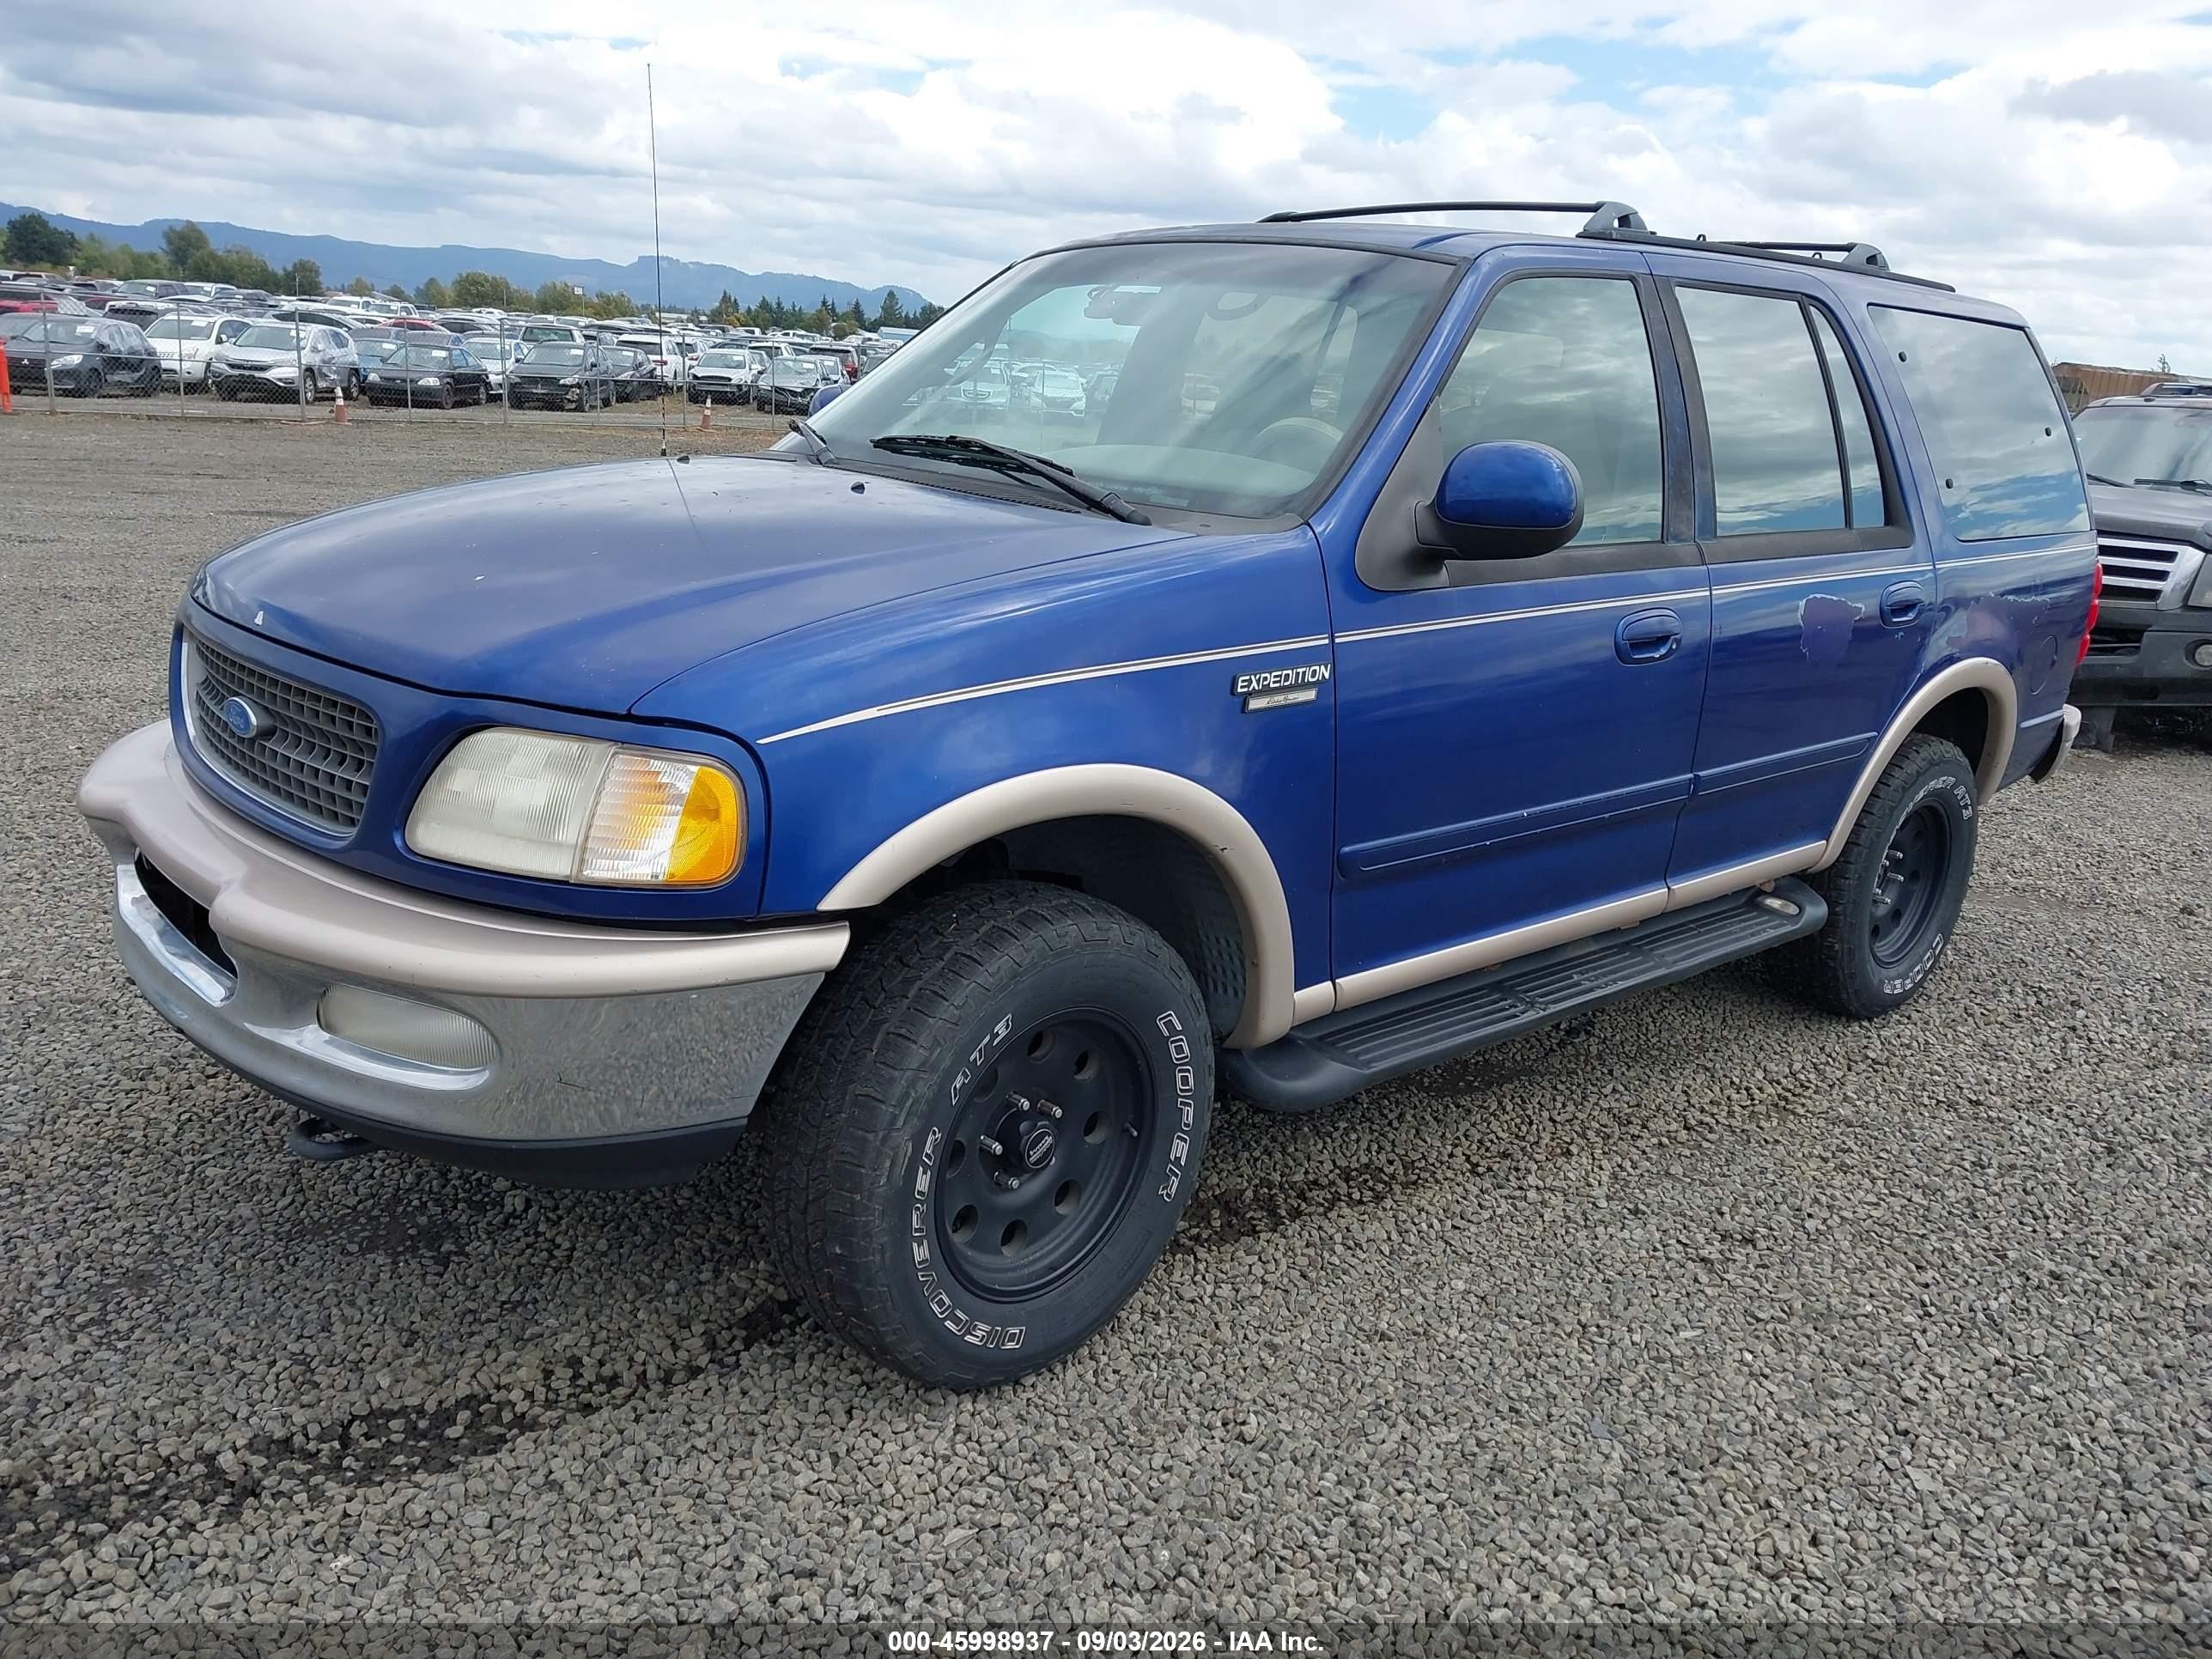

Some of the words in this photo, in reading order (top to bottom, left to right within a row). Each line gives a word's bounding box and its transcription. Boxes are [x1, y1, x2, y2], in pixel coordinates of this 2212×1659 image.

[1237, 664, 1331, 693] EXPEDITION
[1883, 933, 1944, 994] COOPER
[1157, 1011, 1194, 1203] COOPER
[911, 1126, 1028, 1350] DISCOVERER
